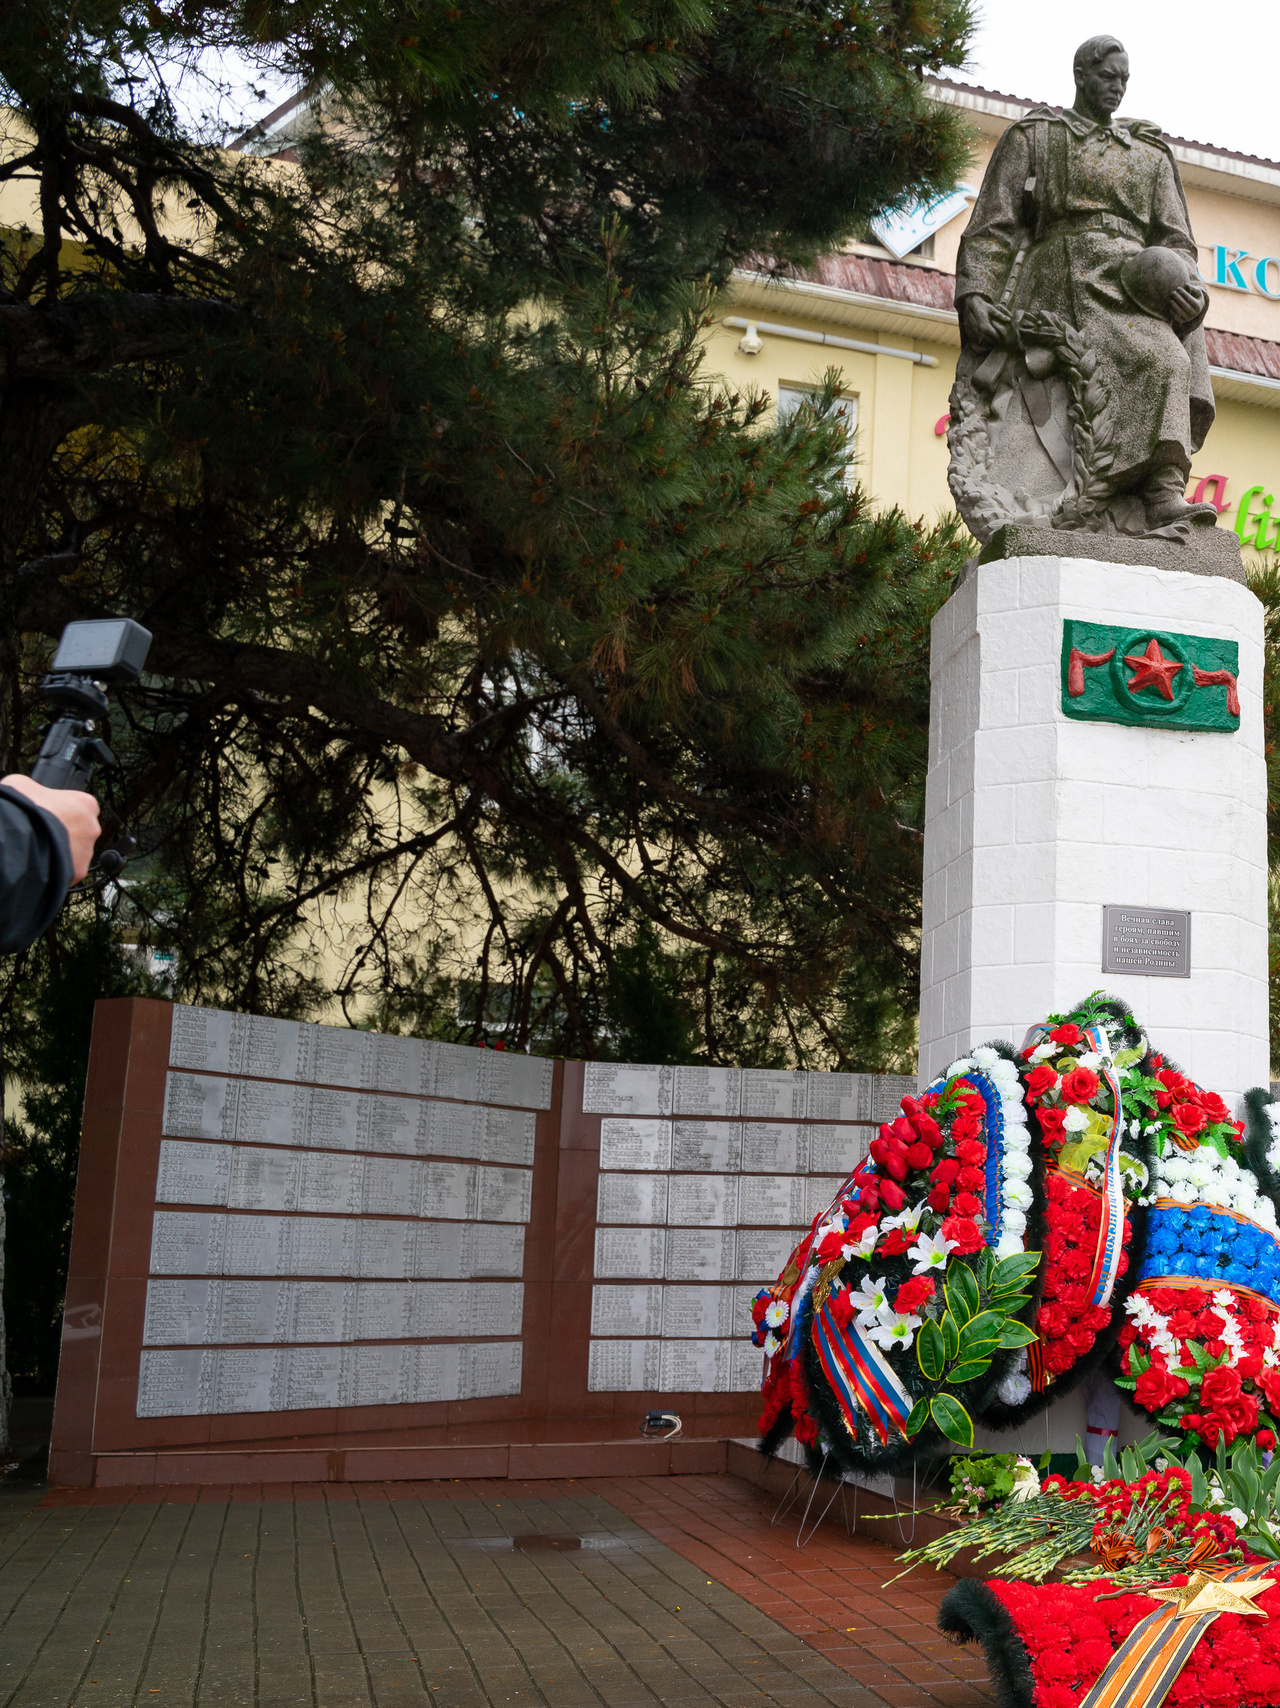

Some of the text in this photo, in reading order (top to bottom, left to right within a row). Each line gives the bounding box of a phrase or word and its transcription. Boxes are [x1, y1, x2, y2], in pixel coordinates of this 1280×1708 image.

[1121, 914, 1175, 926] Вечная слава
[1114, 926, 1180, 937] героям, павшим
[1120, 935, 1139, 943] боях
[1150, 938, 1181, 948] свободу
[1121, 947, 1181, 957] независимость
[1116, 956, 1178, 967] нашей Родины.
